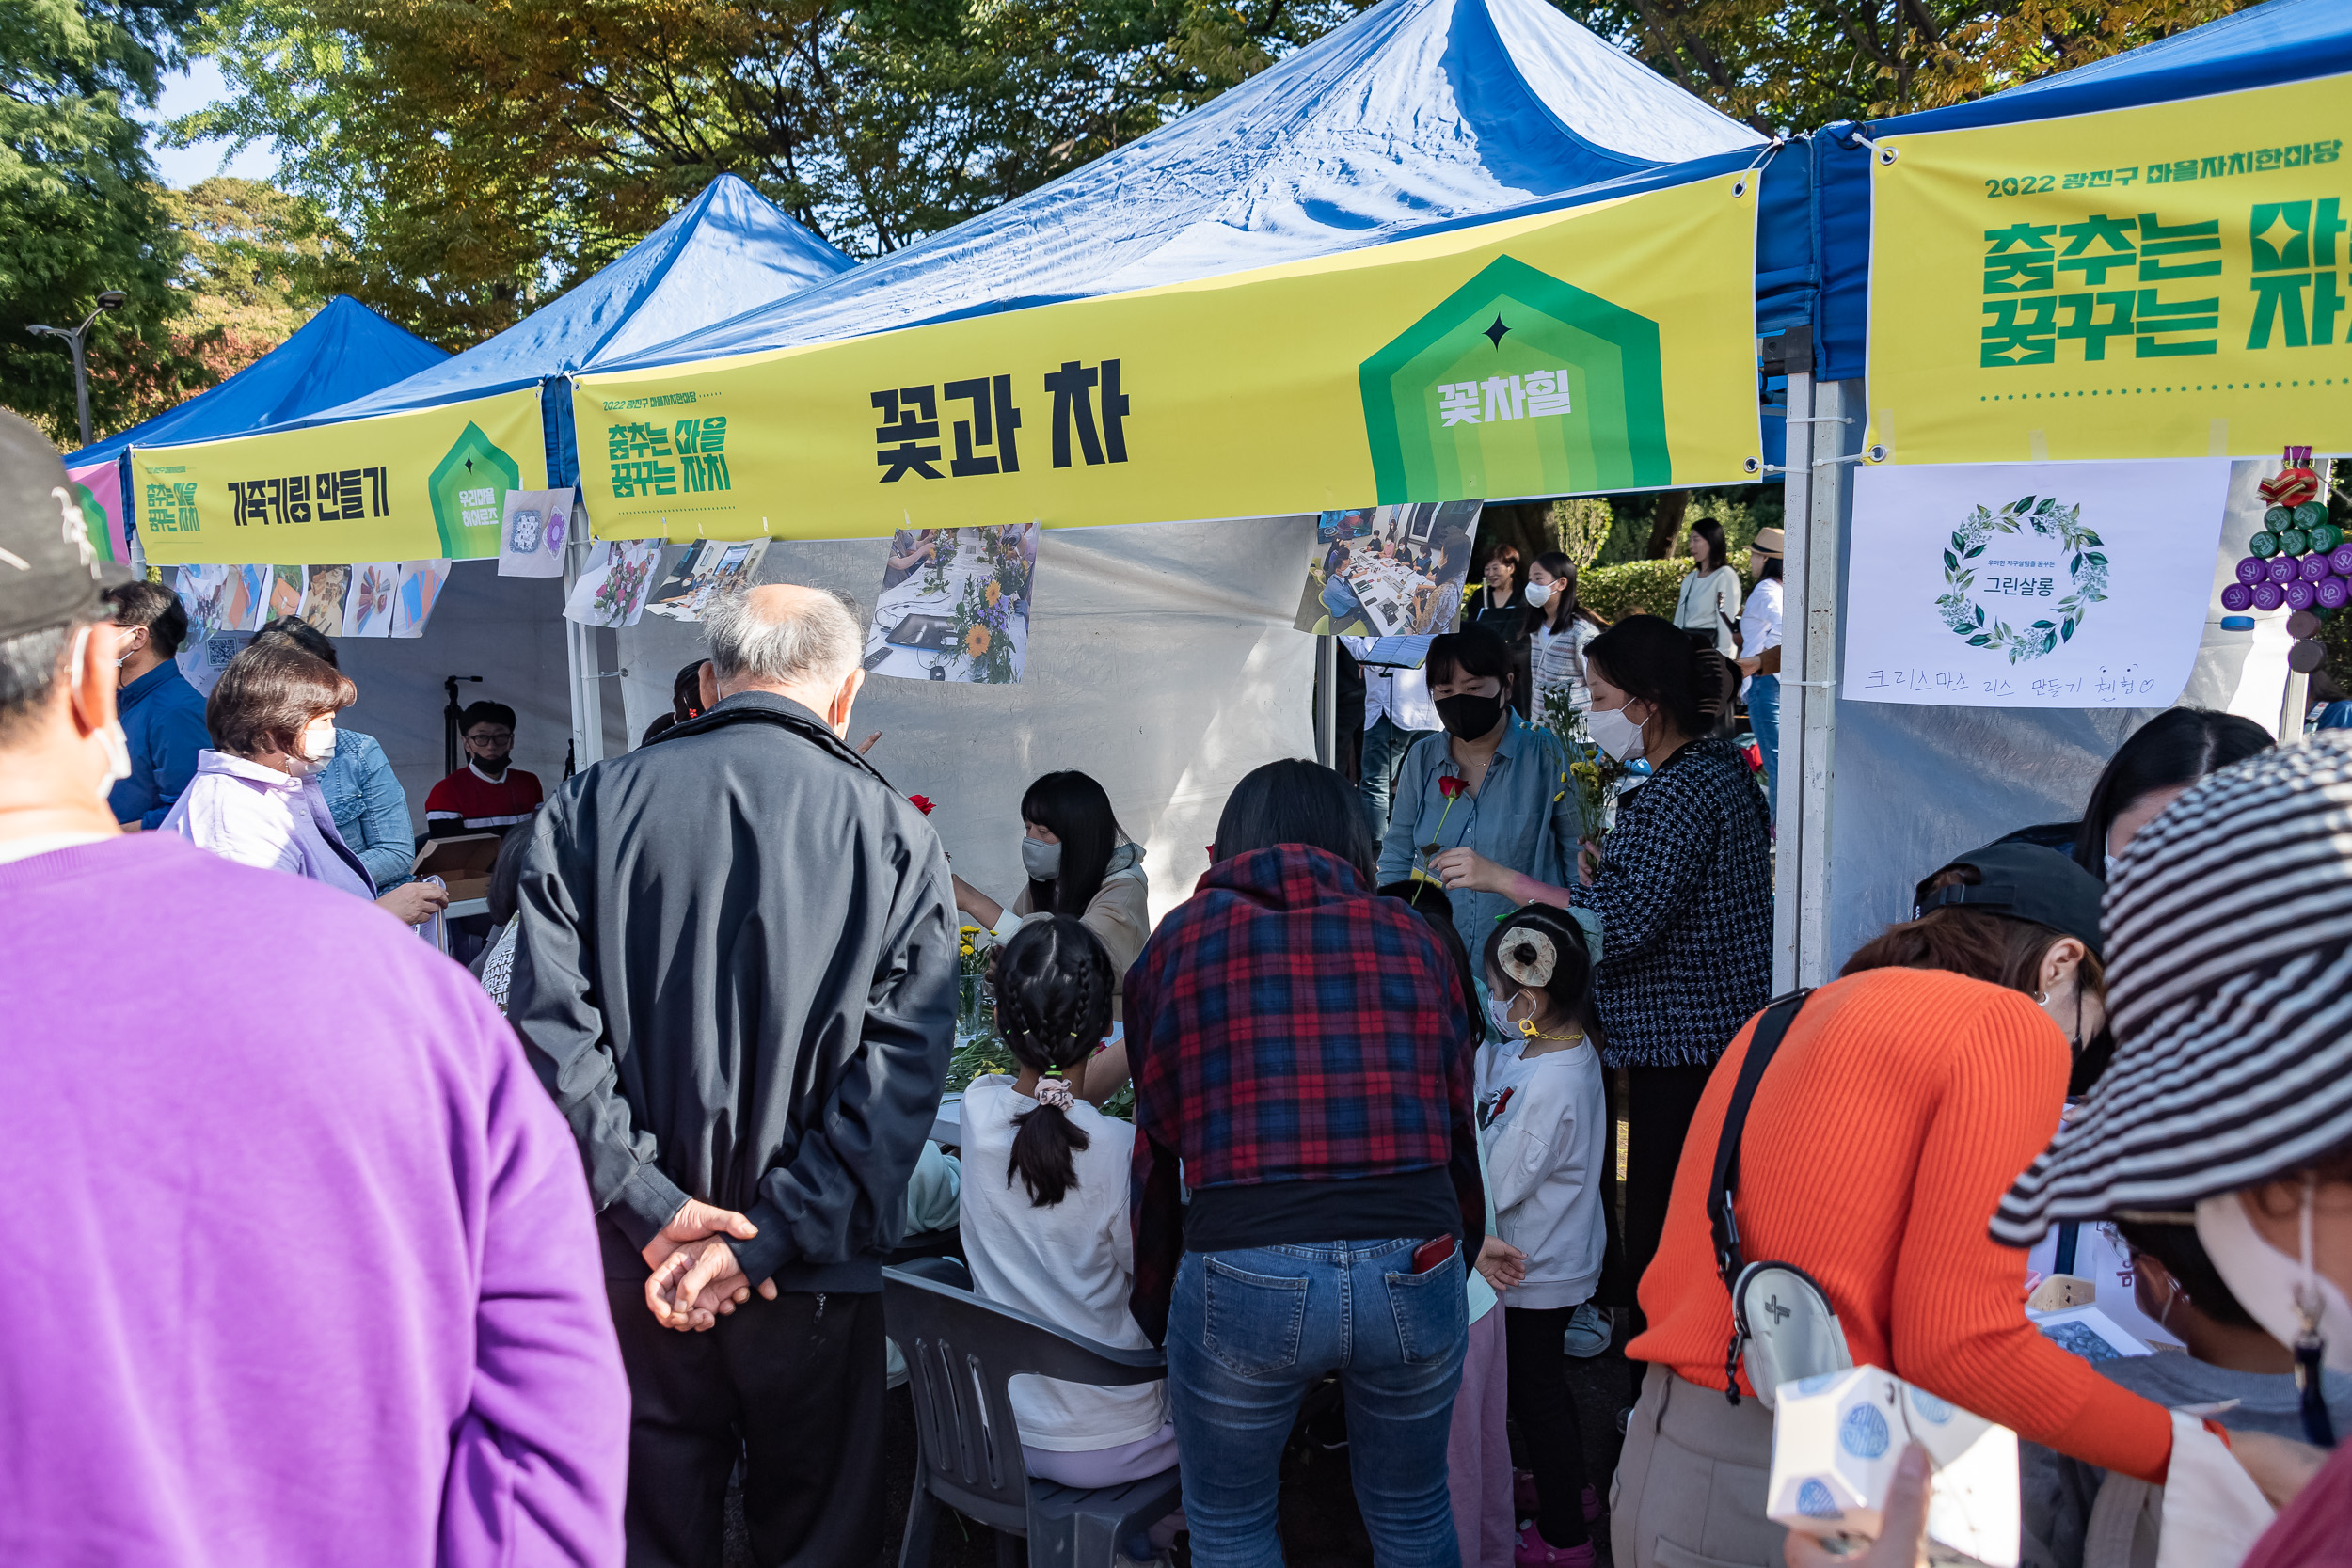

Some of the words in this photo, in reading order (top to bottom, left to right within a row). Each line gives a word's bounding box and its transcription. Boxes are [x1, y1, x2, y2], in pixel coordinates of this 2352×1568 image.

[1985, 174, 2056, 198] 2022
[2061, 166, 2139, 191] 광진구
[2146, 139, 2344, 184] 마을자치한마당
[1983, 212, 2222, 295] 춤추는
[1980, 287, 2219, 368] 꿈꾸는
[602, 400, 626, 411] 2022
[627, 398, 649, 410] 광진구
[869, 373, 1022, 484] 꽃과
[1043, 357, 1131, 469] 차
[1438, 369, 1571, 428] 꽃차힐
[608, 421, 673, 461] 춤추는
[675, 416, 727, 455] 마을
[228, 475, 312, 526] 가죽키링
[316, 466, 389, 522] 만들기
[458, 487, 496, 508] 우리마을
[611, 460, 677, 499] 꿈꾸는
[679, 453, 731, 493] 자치
[178, 506, 200, 531] 자치
[461, 507, 499, 527] 히어로즈
[1988, 559, 2006, 567] 우아한
[2007, 560, 2036, 568] 지구살림을
[1983, 577, 2055, 597] 그린살롱
[1865, 668, 1969, 691] 크리스마스
[1983, 679, 2014, 697] 리스
[2031, 677, 2083, 698] 만들기
